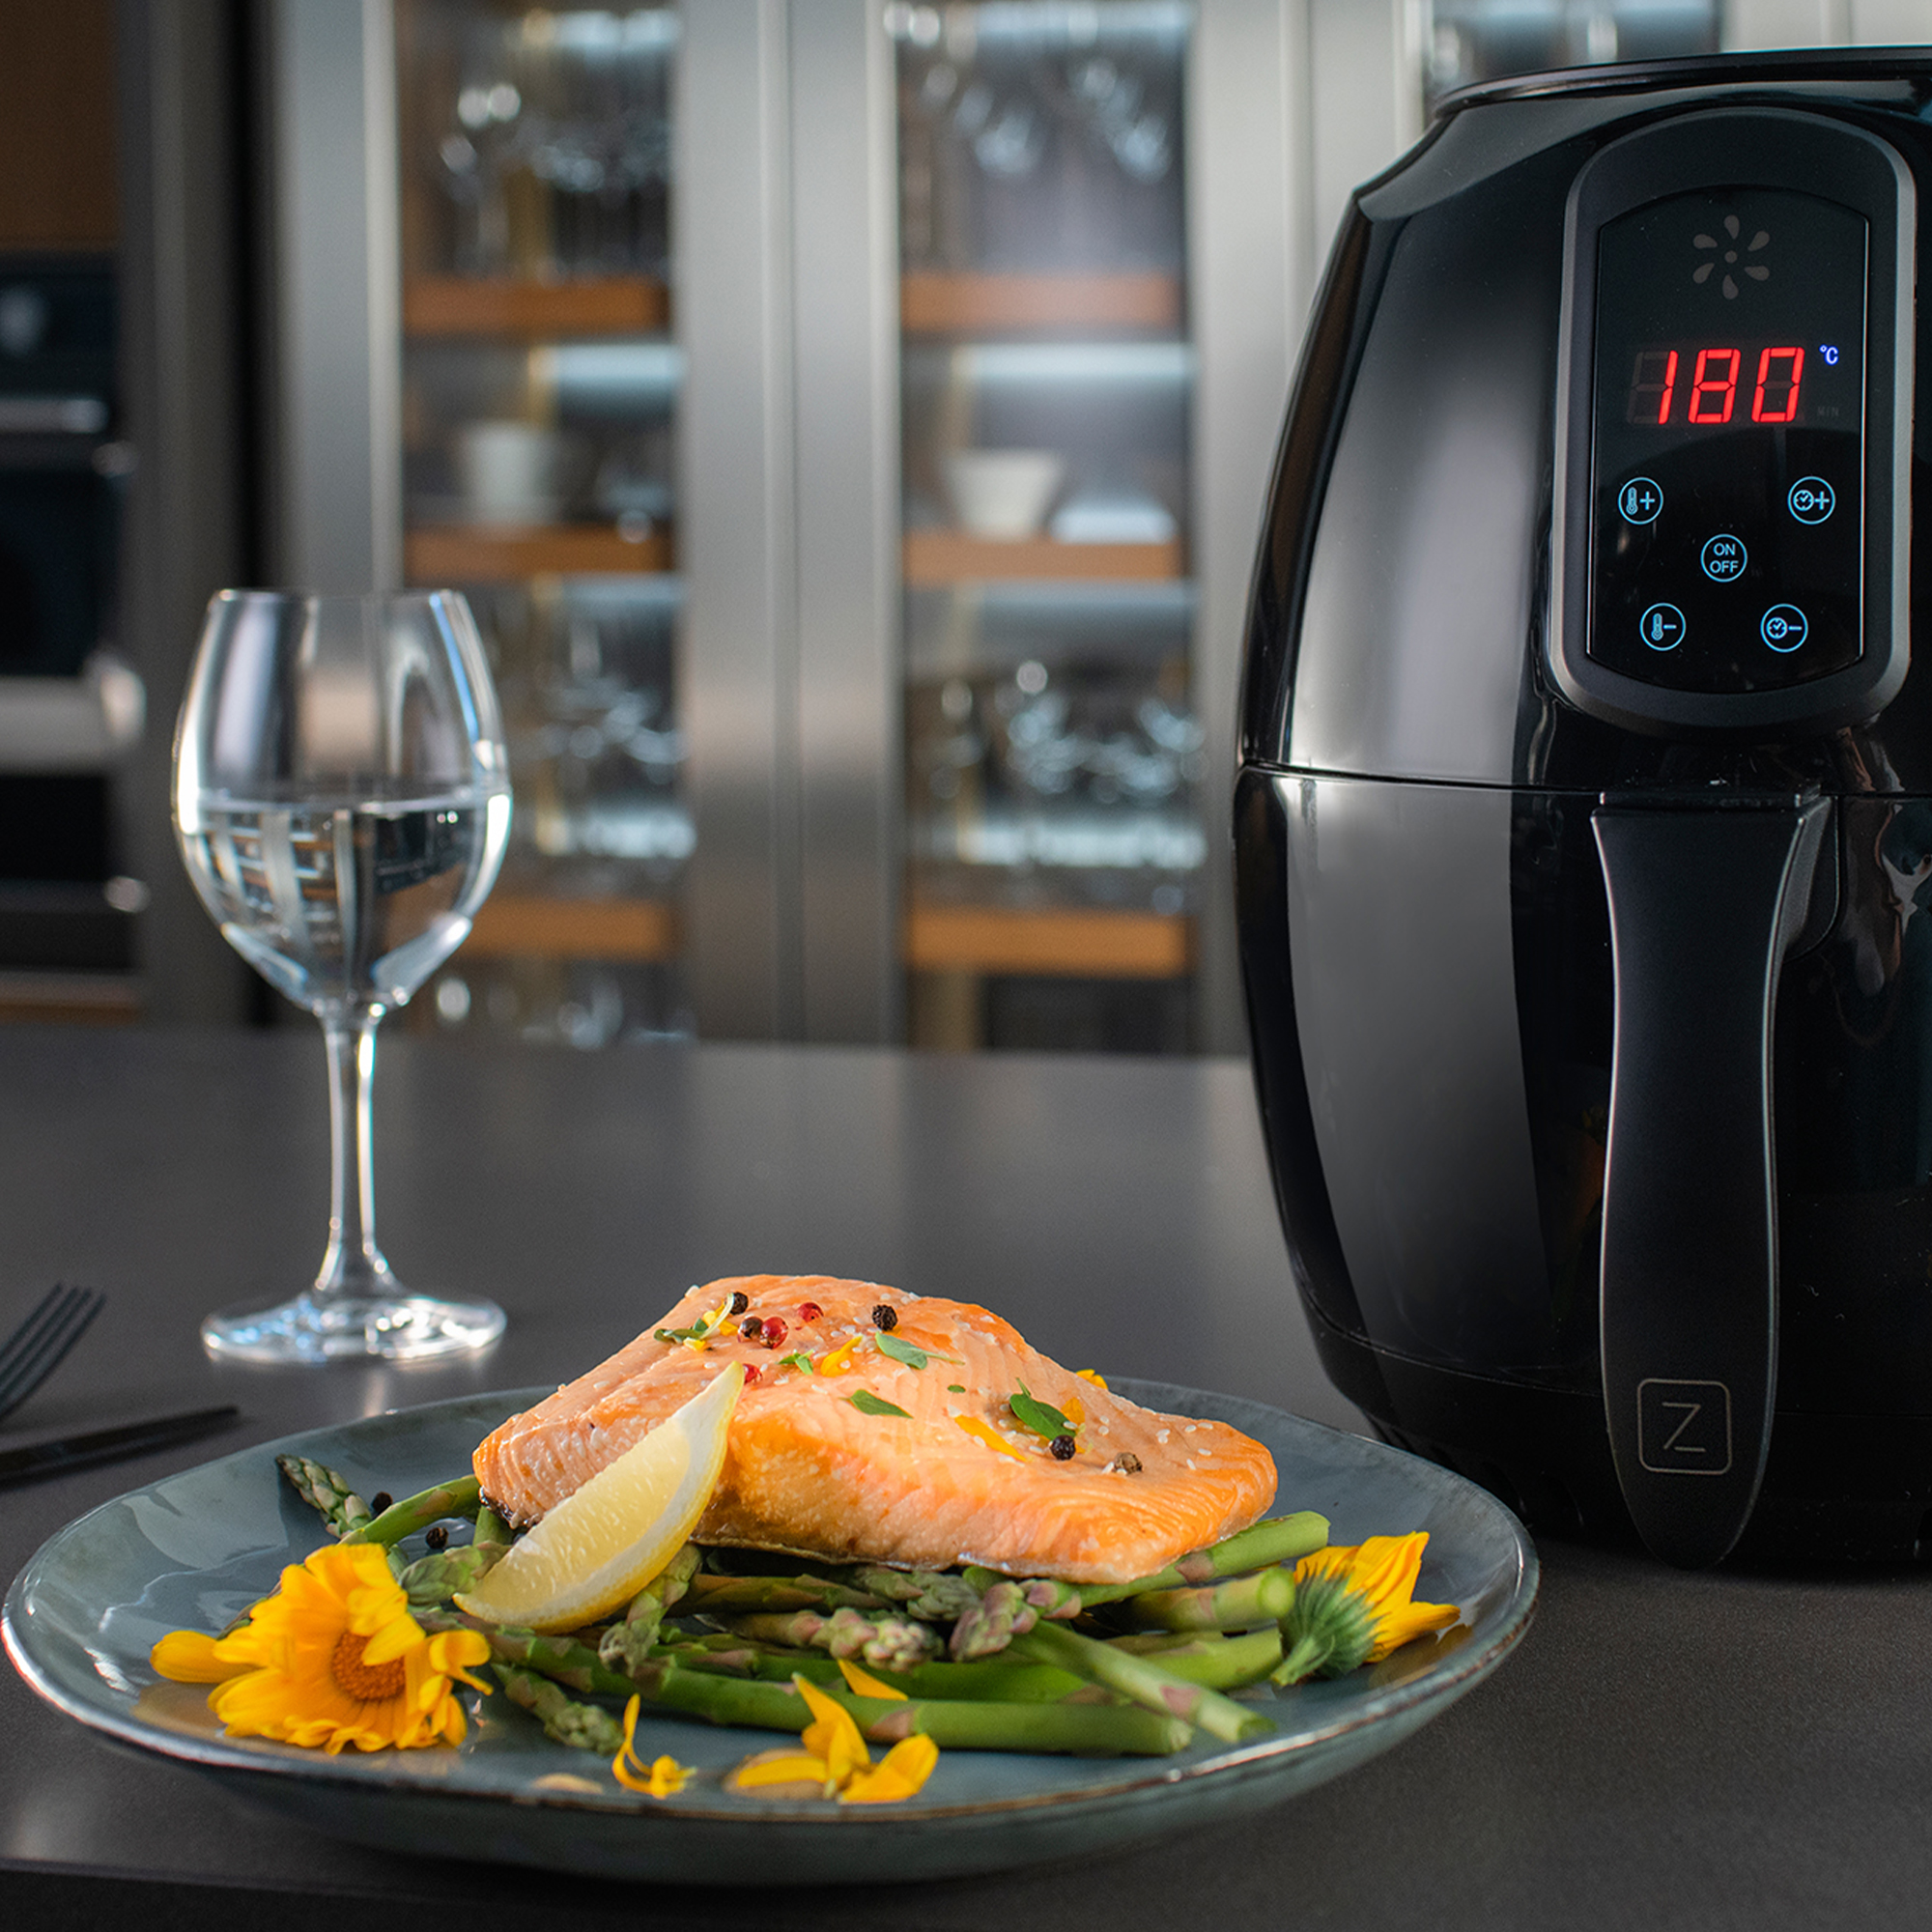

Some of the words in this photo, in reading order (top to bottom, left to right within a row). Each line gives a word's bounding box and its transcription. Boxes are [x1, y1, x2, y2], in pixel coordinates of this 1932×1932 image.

[1659, 347, 1804, 424] 180
[1819, 344, 1839, 366] °C
[1713, 542, 1736, 556] ON
[1709, 559, 1739, 574] OFF
[1662, 1401, 1706, 1453] Z
